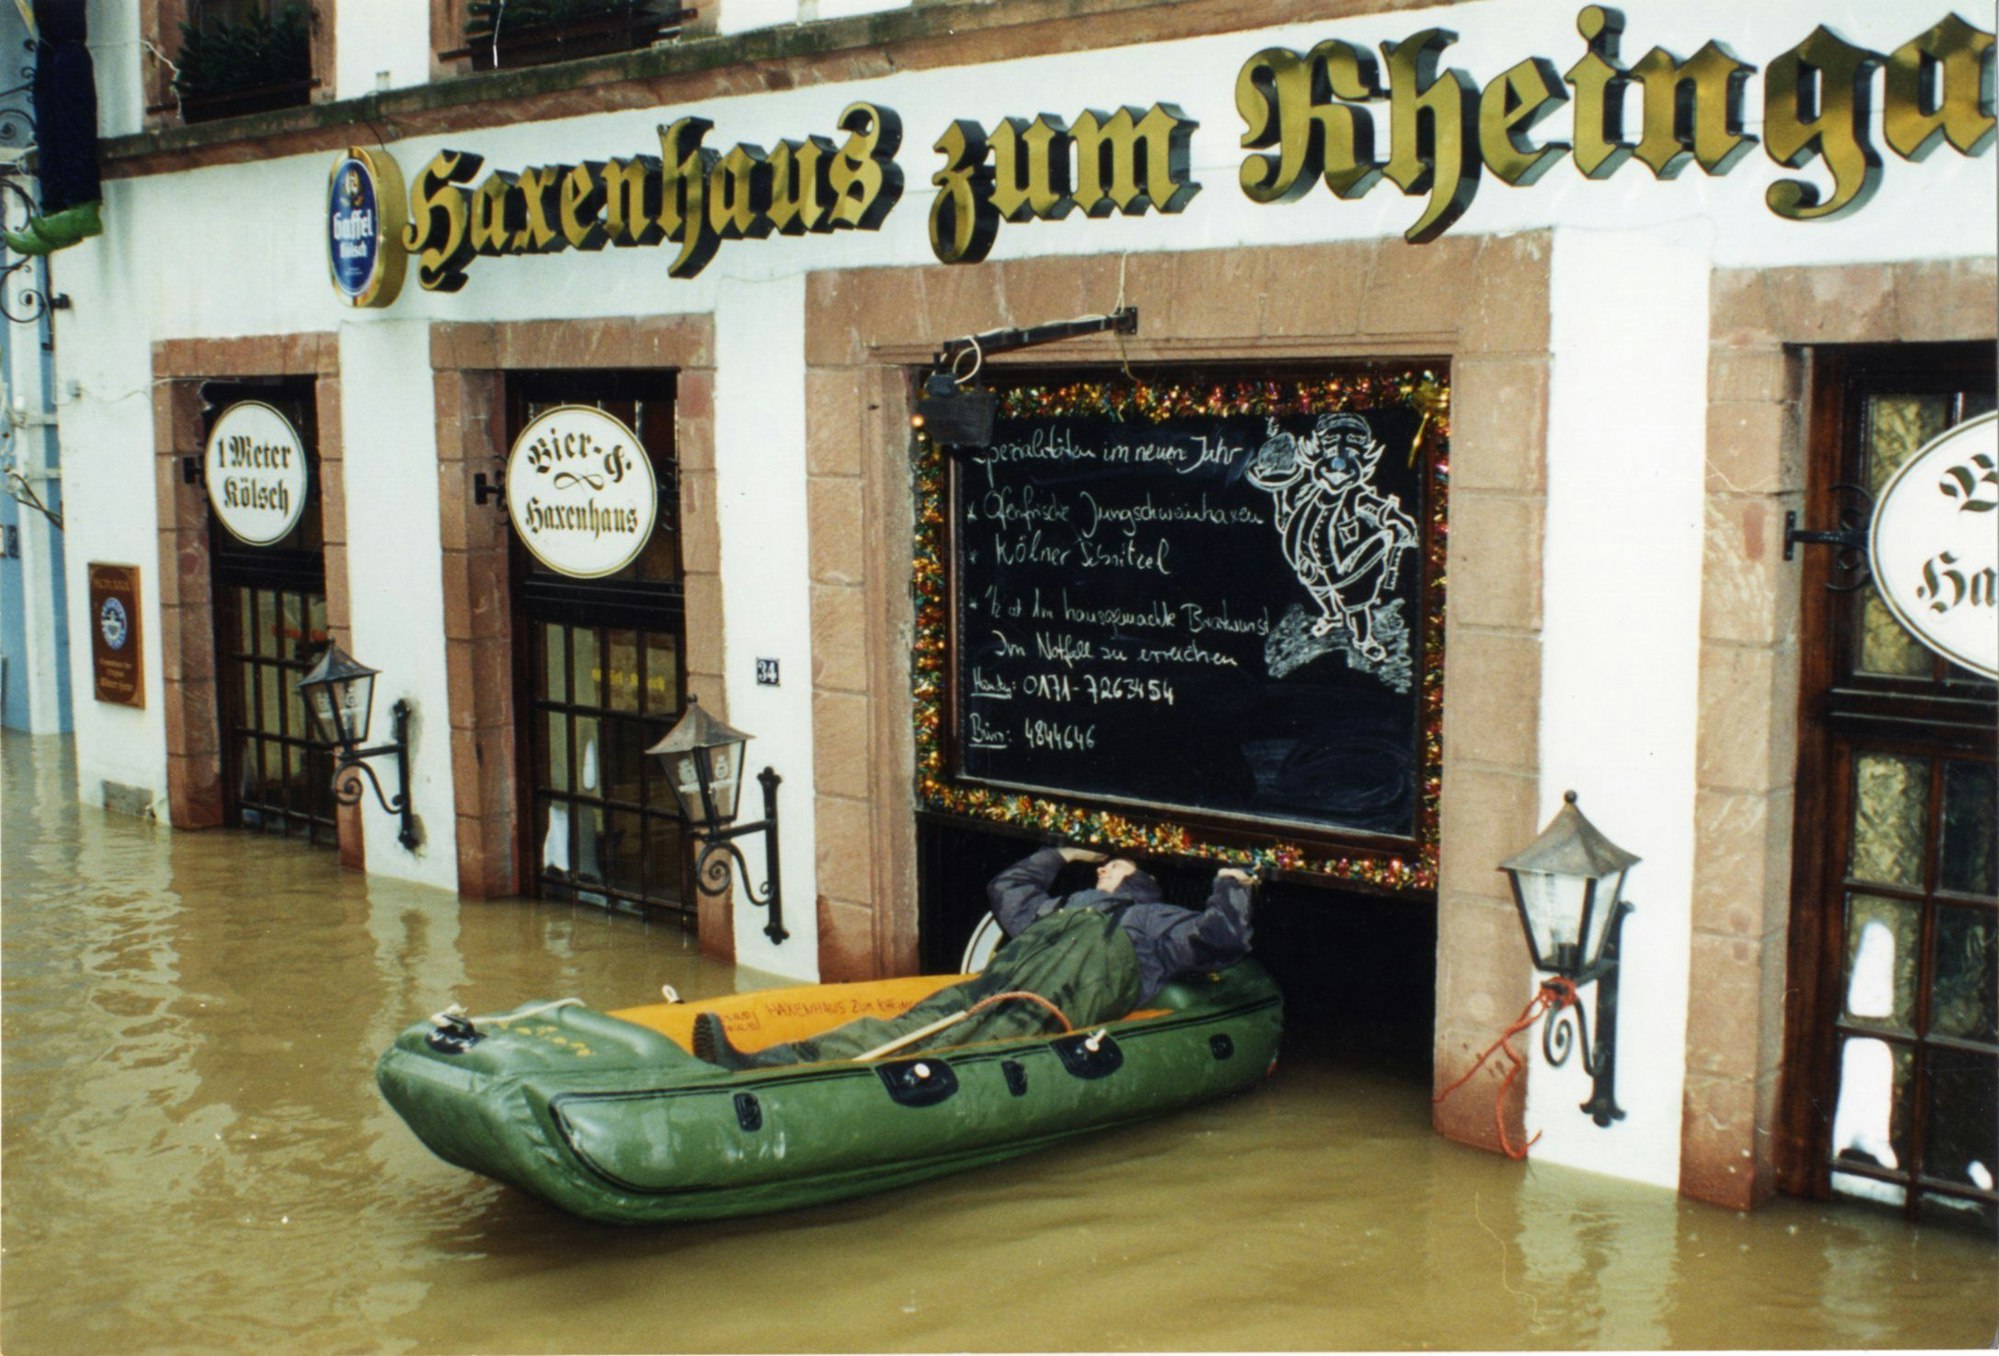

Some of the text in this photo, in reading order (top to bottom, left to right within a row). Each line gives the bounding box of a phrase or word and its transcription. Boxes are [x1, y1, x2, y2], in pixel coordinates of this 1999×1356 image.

[402, 101, 904, 292] Haxenhaus
[928, 101, 1202, 264] zum
[217, 435, 292, 470] 1 Meter
[526, 427, 602, 474] Bier-
[972, 424, 1097, 489] pezialitäten
[1103, 441, 1129, 463] im
[1176, 434, 1244, 475] Jahr
[223, 476, 289, 519] Kölsch
[525, 497, 639, 542] Haxenhaus
[995, 529, 1071, 566] Kölner
[757, 661, 778, 683] 34
[1136, 639, 1239, 667] erreichen
[1025, 717, 1097, 751] 4844646
